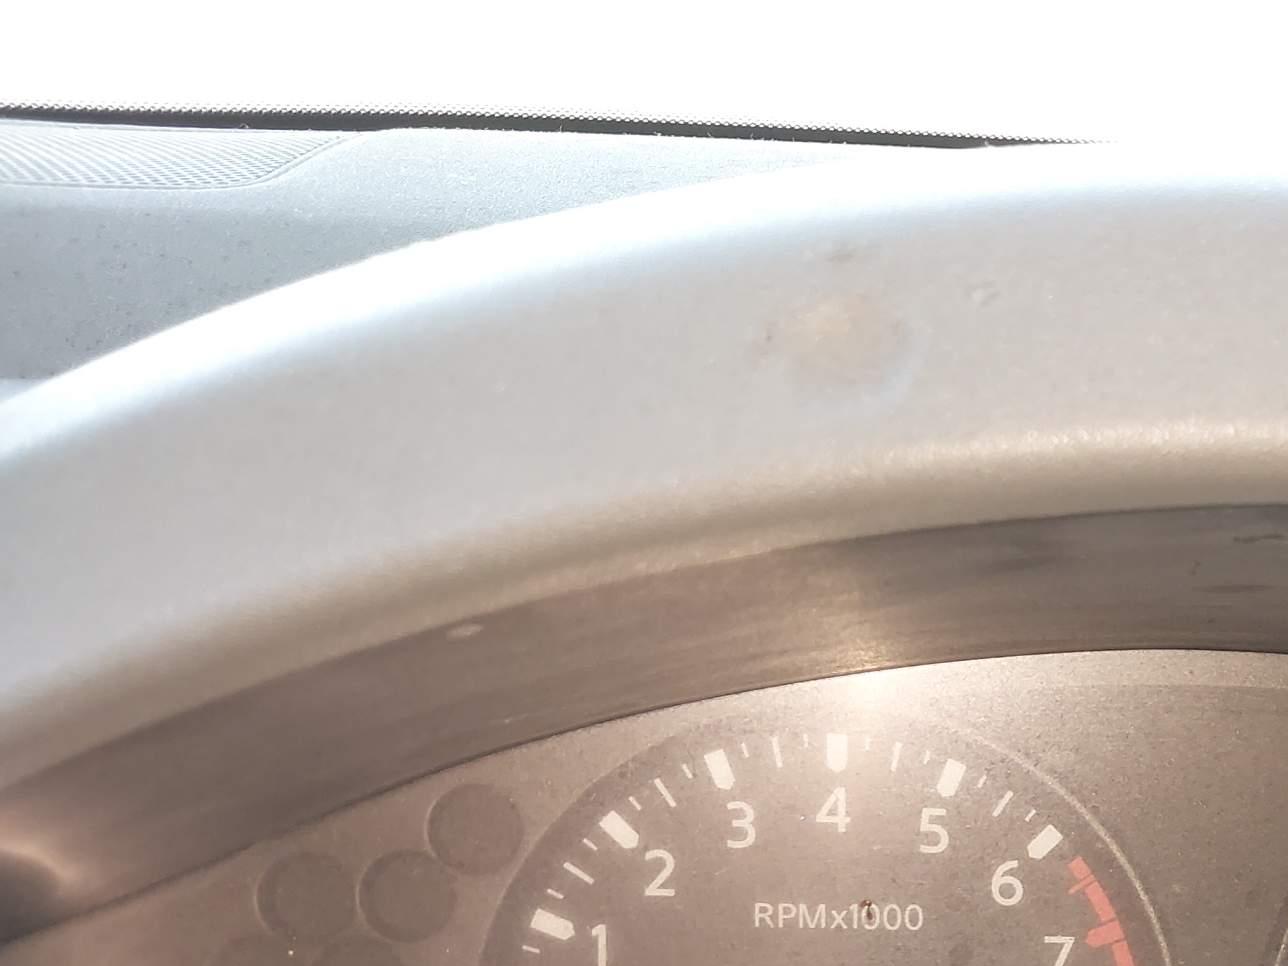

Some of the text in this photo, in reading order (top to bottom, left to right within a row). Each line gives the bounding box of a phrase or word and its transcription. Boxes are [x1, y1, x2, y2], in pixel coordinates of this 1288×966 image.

[726, 800, 757, 849] 3
[815, 786, 851, 833] 4
[919, 807, 949, 854] 5
[643, 848, 676, 897] 2
[991, 859, 1024, 906] 6
[754, 902, 924, 931] RPMx1000
